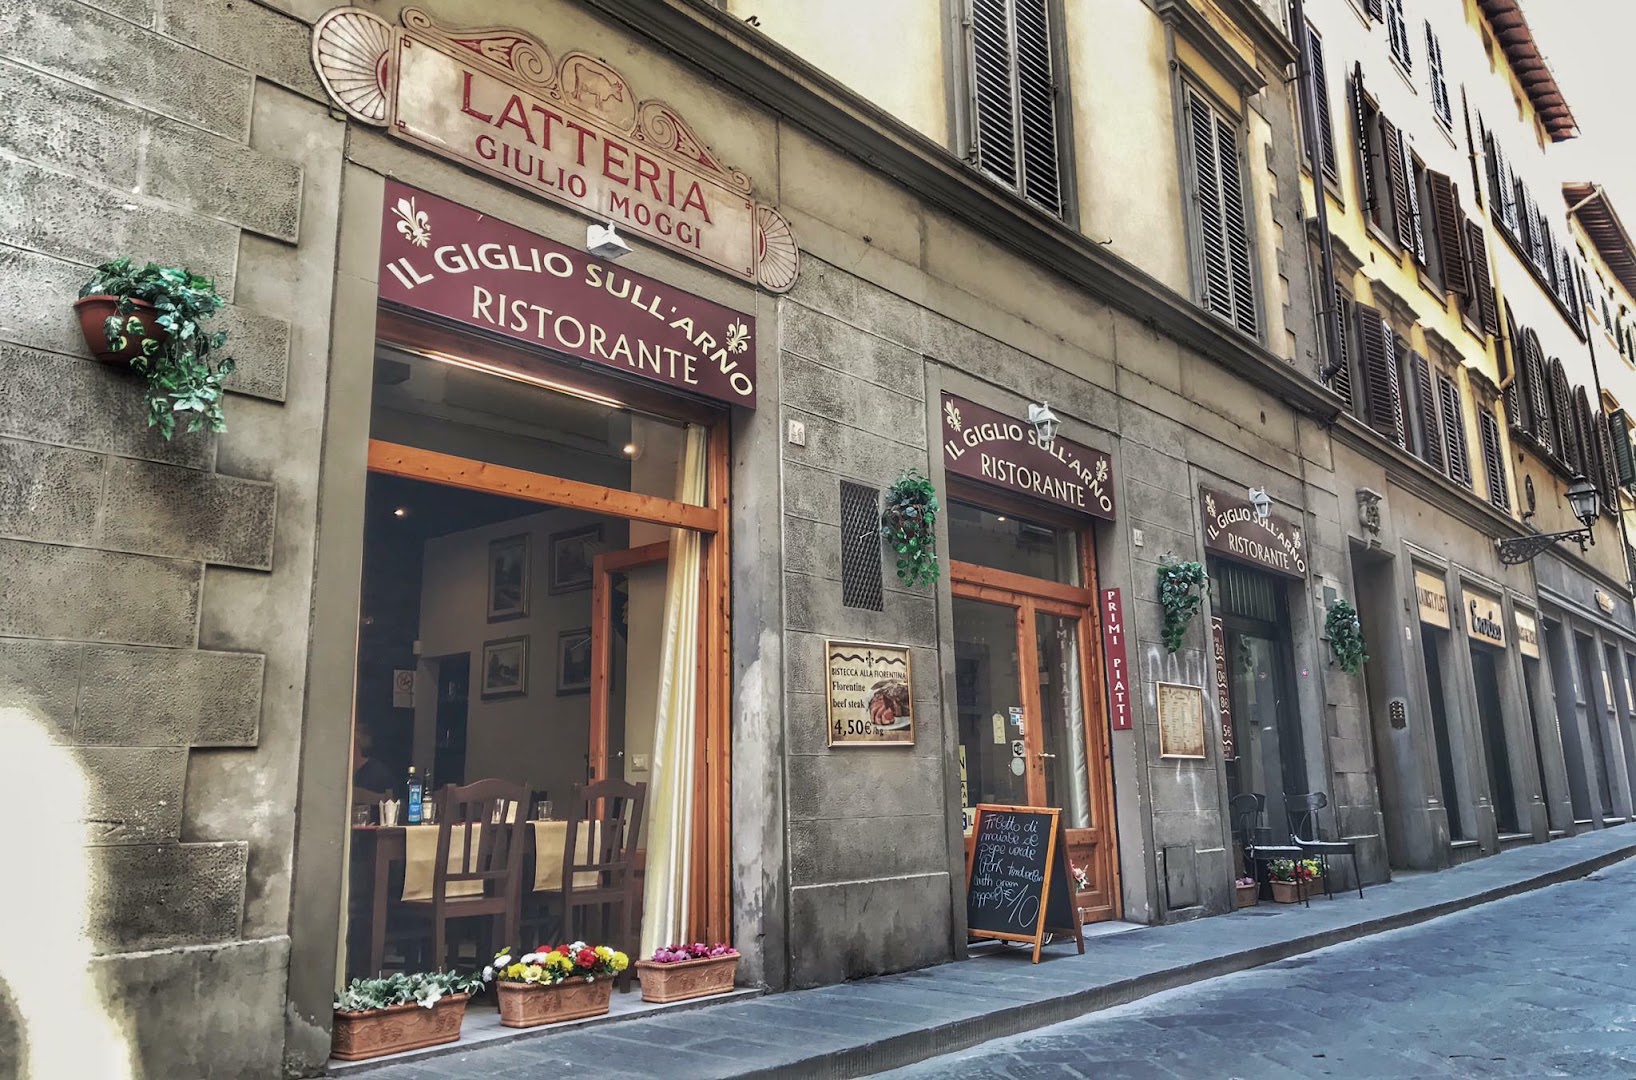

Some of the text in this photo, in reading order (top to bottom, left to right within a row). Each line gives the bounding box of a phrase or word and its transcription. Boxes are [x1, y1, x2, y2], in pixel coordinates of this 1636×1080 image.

[460, 70, 713, 225] LATTERIA
[475, 135, 702, 249] GIULIO MOGGI
[386, 243, 753, 396] IL GIGLIO SULL'ARNO
[472, 285, 699, 386] RISTORANTE
[945, 423, 1112, 512] IL GIGLIO SULL'ARNO
[981, 453, 1085, 507] RISTORANTE
[1207, 525, 1219, 540] IL
[1217, 508, 1251, 529] GIGLIO
[1228, 532, 1290, 569] RISTORANTE
[1107, 591, 1121, 645] PRIMI
[831, 667, 906, 680] BISTECCA ALLA FIORENTINA
[832, 681, 866, 692] Florentine
[1113, 658, 1126, 726] PIATTI
[832, 699, 866, 709] beef steak
[1023, 820, 1039, 833] di
